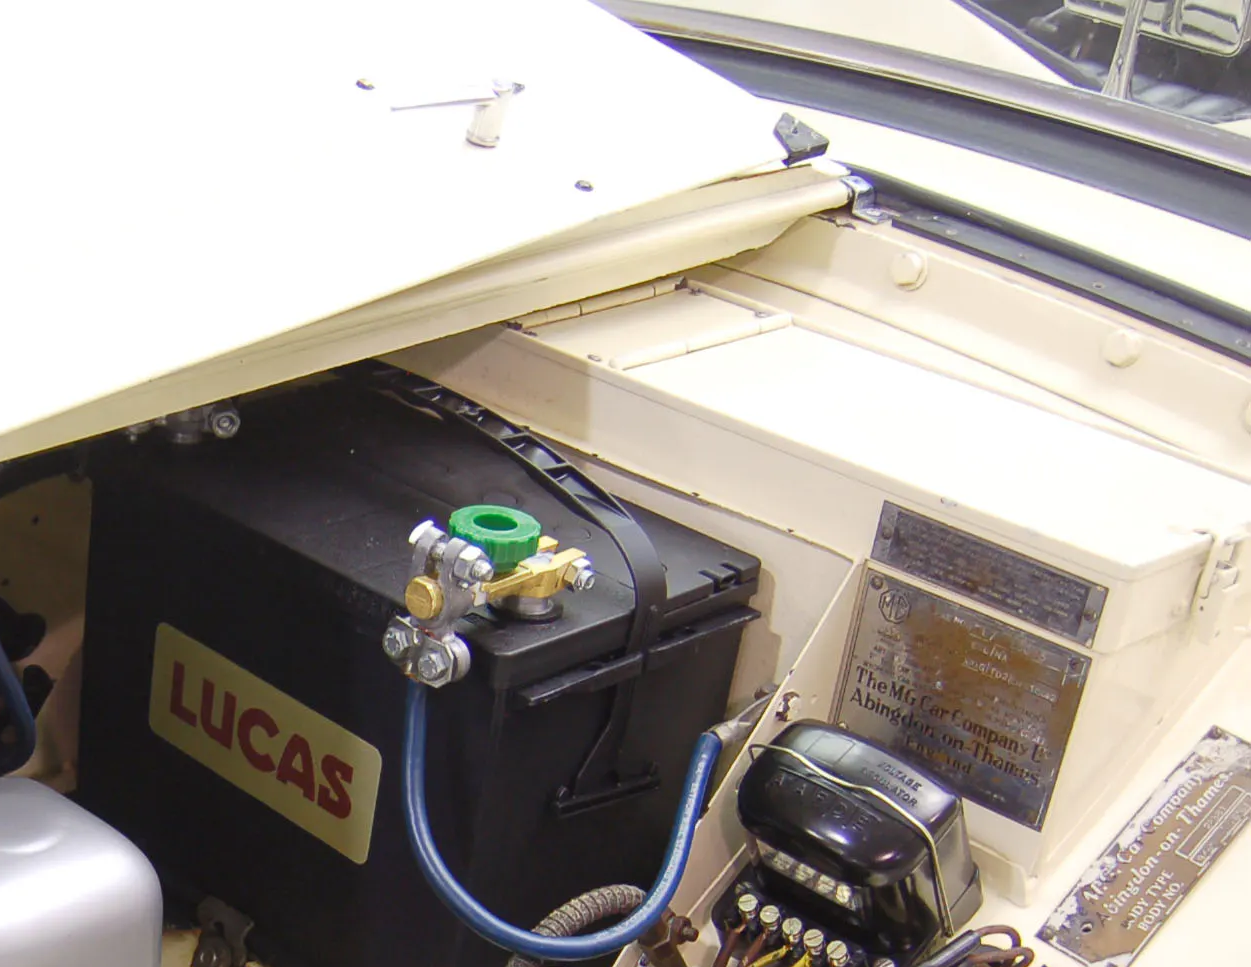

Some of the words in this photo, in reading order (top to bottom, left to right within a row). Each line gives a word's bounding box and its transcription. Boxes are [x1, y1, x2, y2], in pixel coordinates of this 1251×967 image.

[169, 660, 354, 820] LUCAS
[856, 664, 888, 694] The
[888, 680, 917, 707] MG
[919, 695, 950, 720] Car
[951, 708, 1029, 757] Company
[1145, 869, 1174, 897] TYPE
[1137, 899, 1167, 932] BODY
